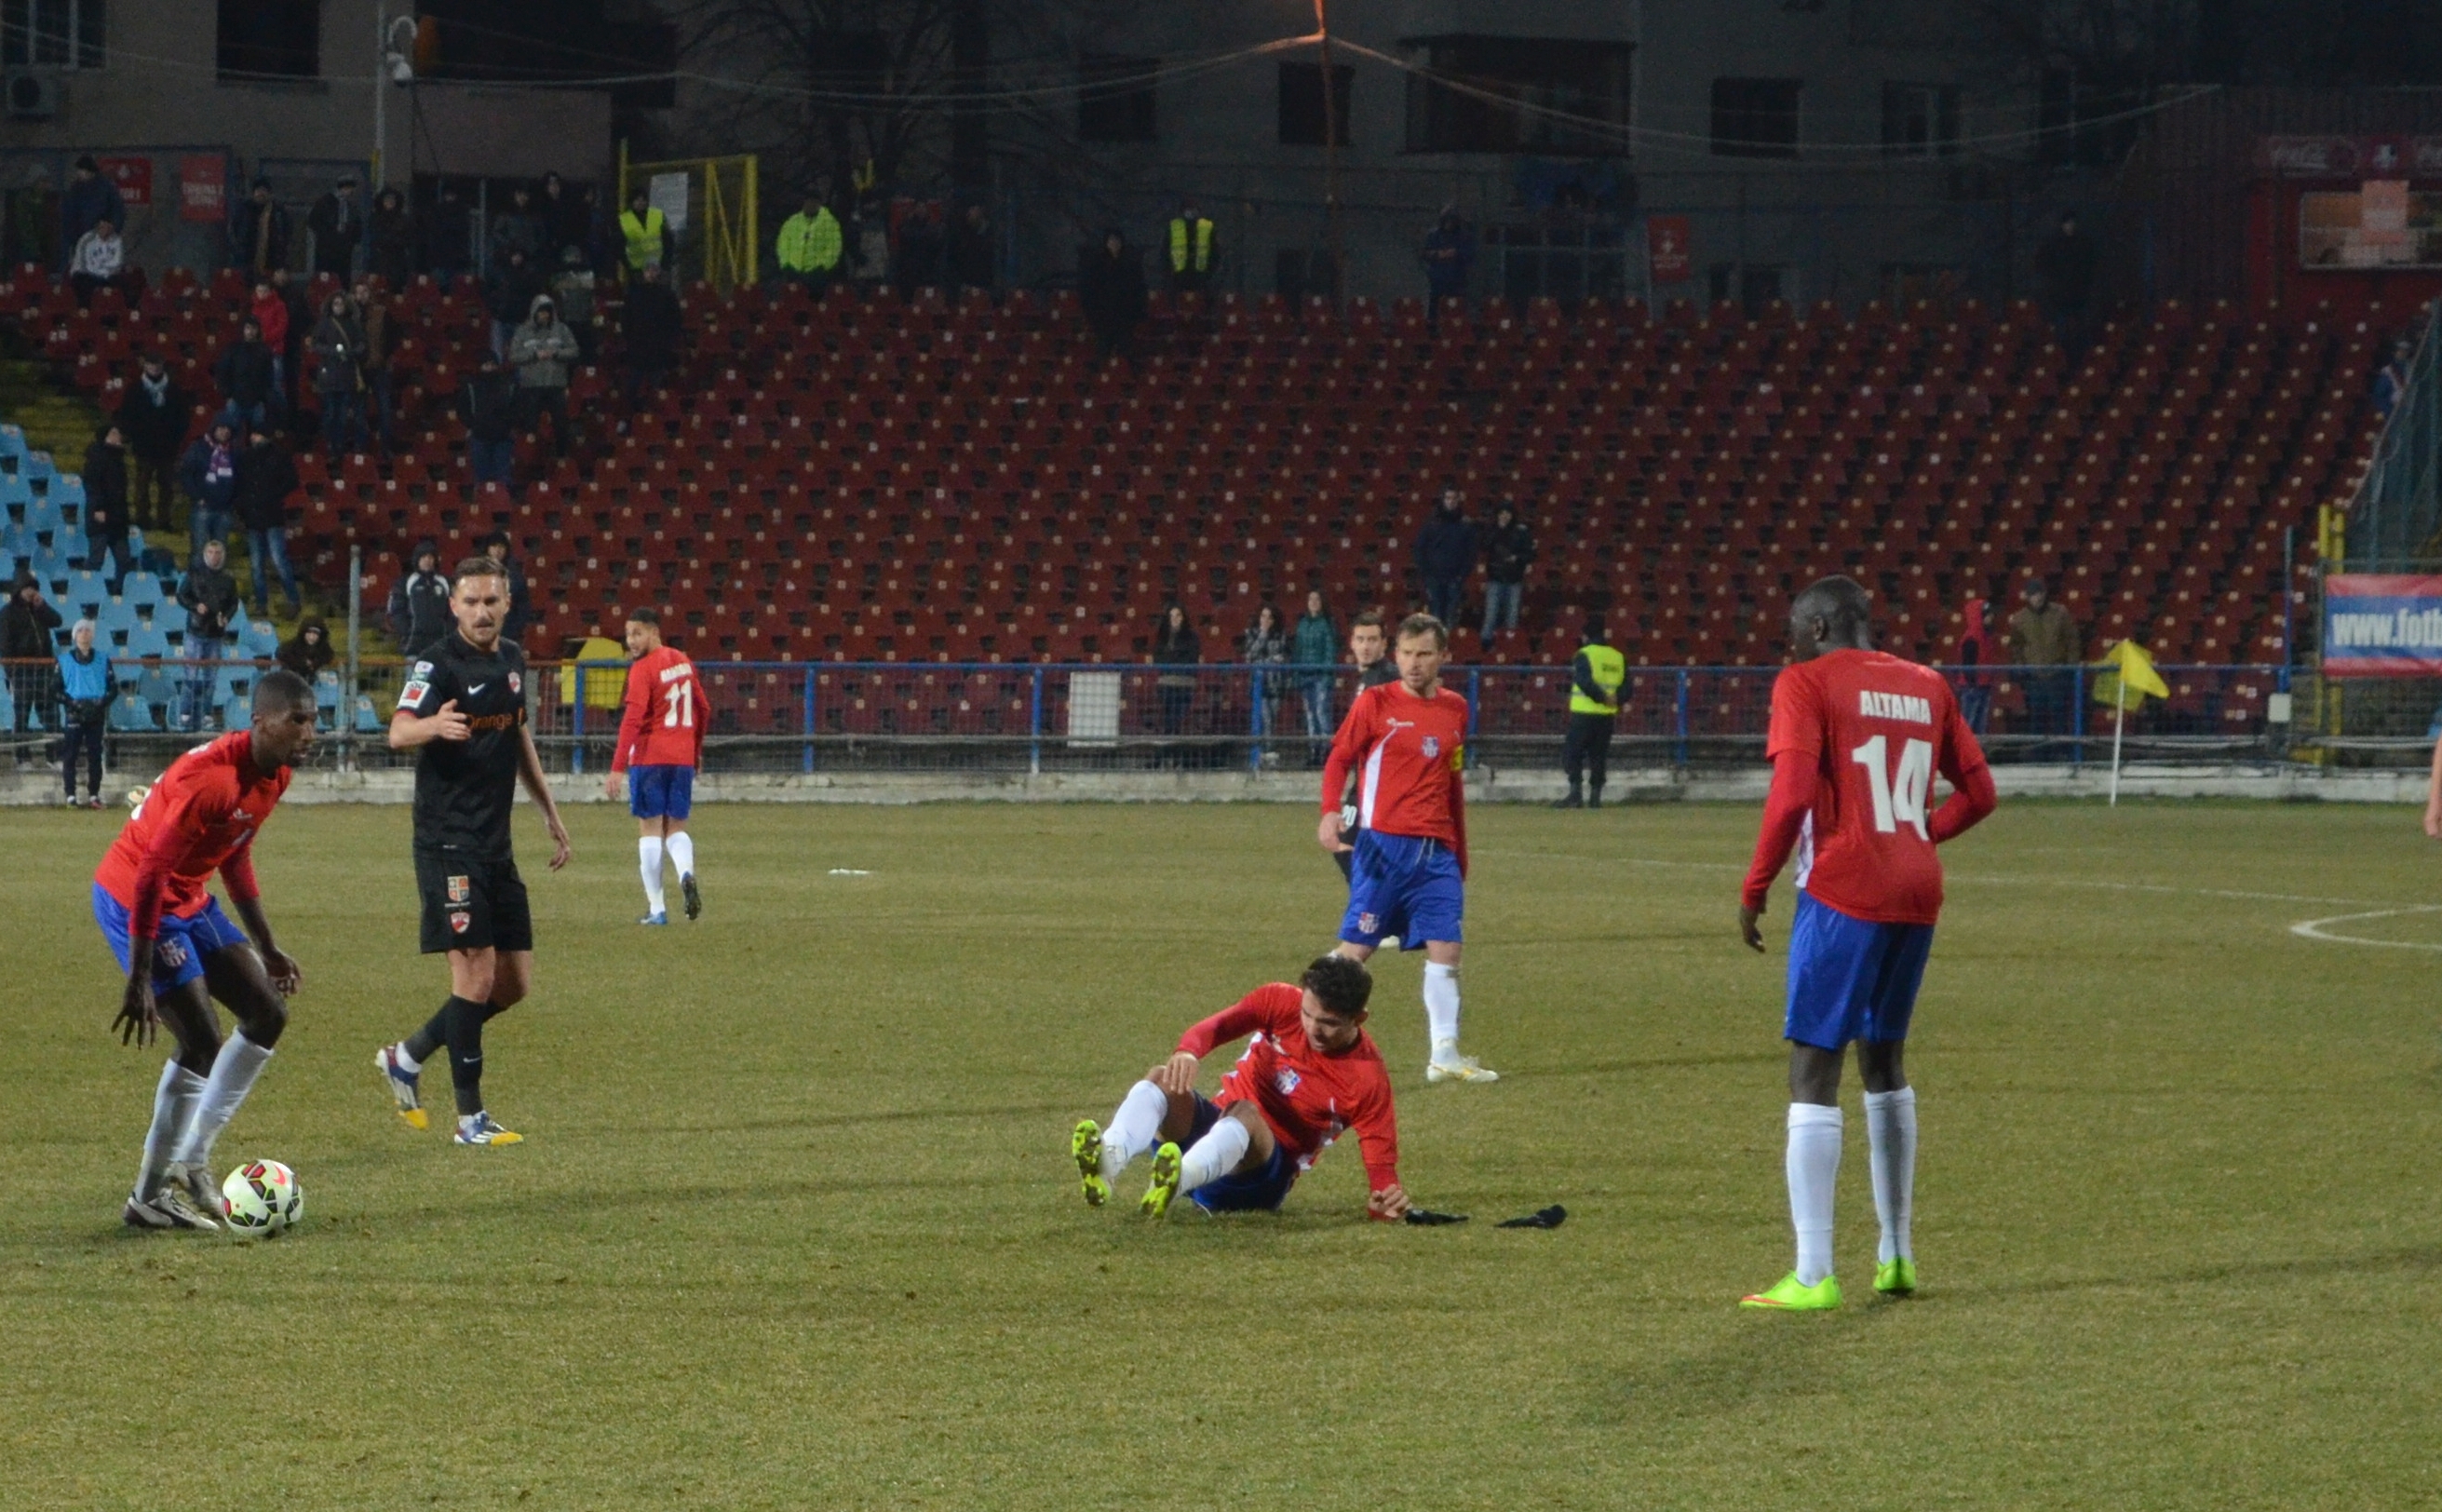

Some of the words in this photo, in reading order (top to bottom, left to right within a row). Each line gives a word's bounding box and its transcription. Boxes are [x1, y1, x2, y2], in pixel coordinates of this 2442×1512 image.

[664, 679, 693, 728] 11
[1860, 689, 1932, 725] ALTAMA
[1852, 735, 1933, 841] 14
